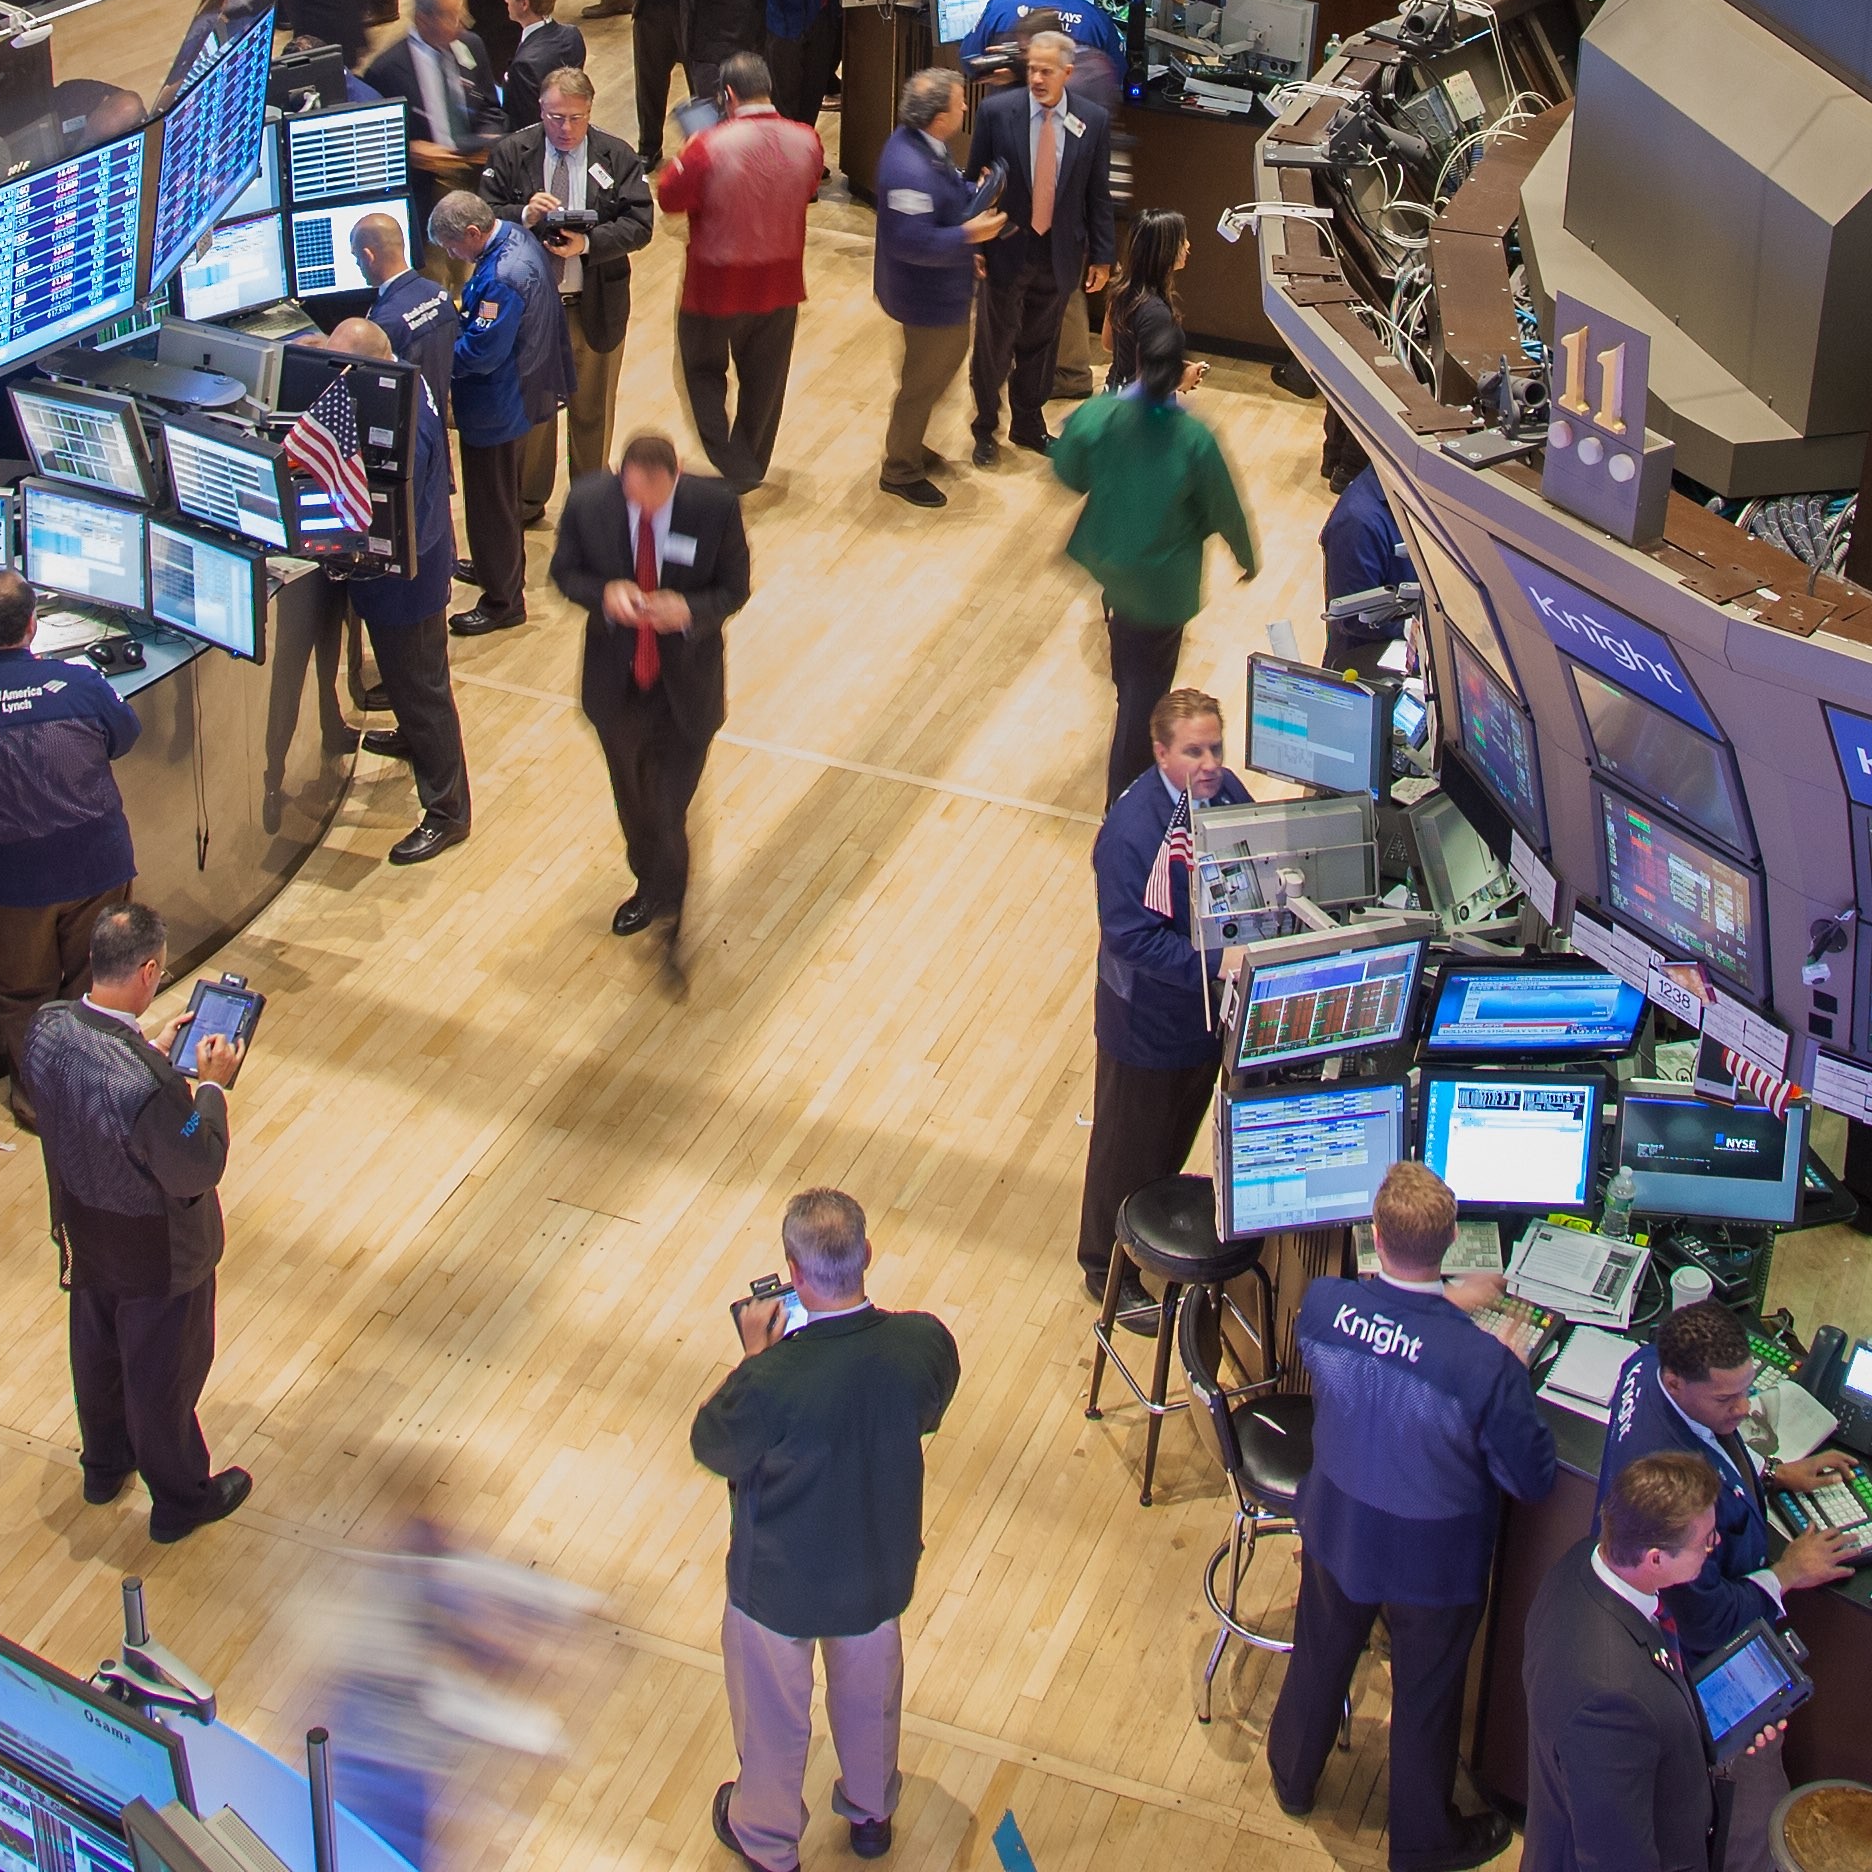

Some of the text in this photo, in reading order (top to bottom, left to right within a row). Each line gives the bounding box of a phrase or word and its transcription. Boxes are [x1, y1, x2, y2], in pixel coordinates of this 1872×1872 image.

[1559, 325, 1627, 435] 11
[1529, 578, 1684, 695] Knight
[2, 698, 33, 713] Lynch
[3, 685, 43, 702] America
[1658, 979, 1692, 1009] 1238
[1725, 1137, 1757, 1153] NYSE
[1332, 1302, 1424, 1363] Knight
[1615, 1358, 1644, 1443] Knight
[83, 1708, 133, 1745] Osama
